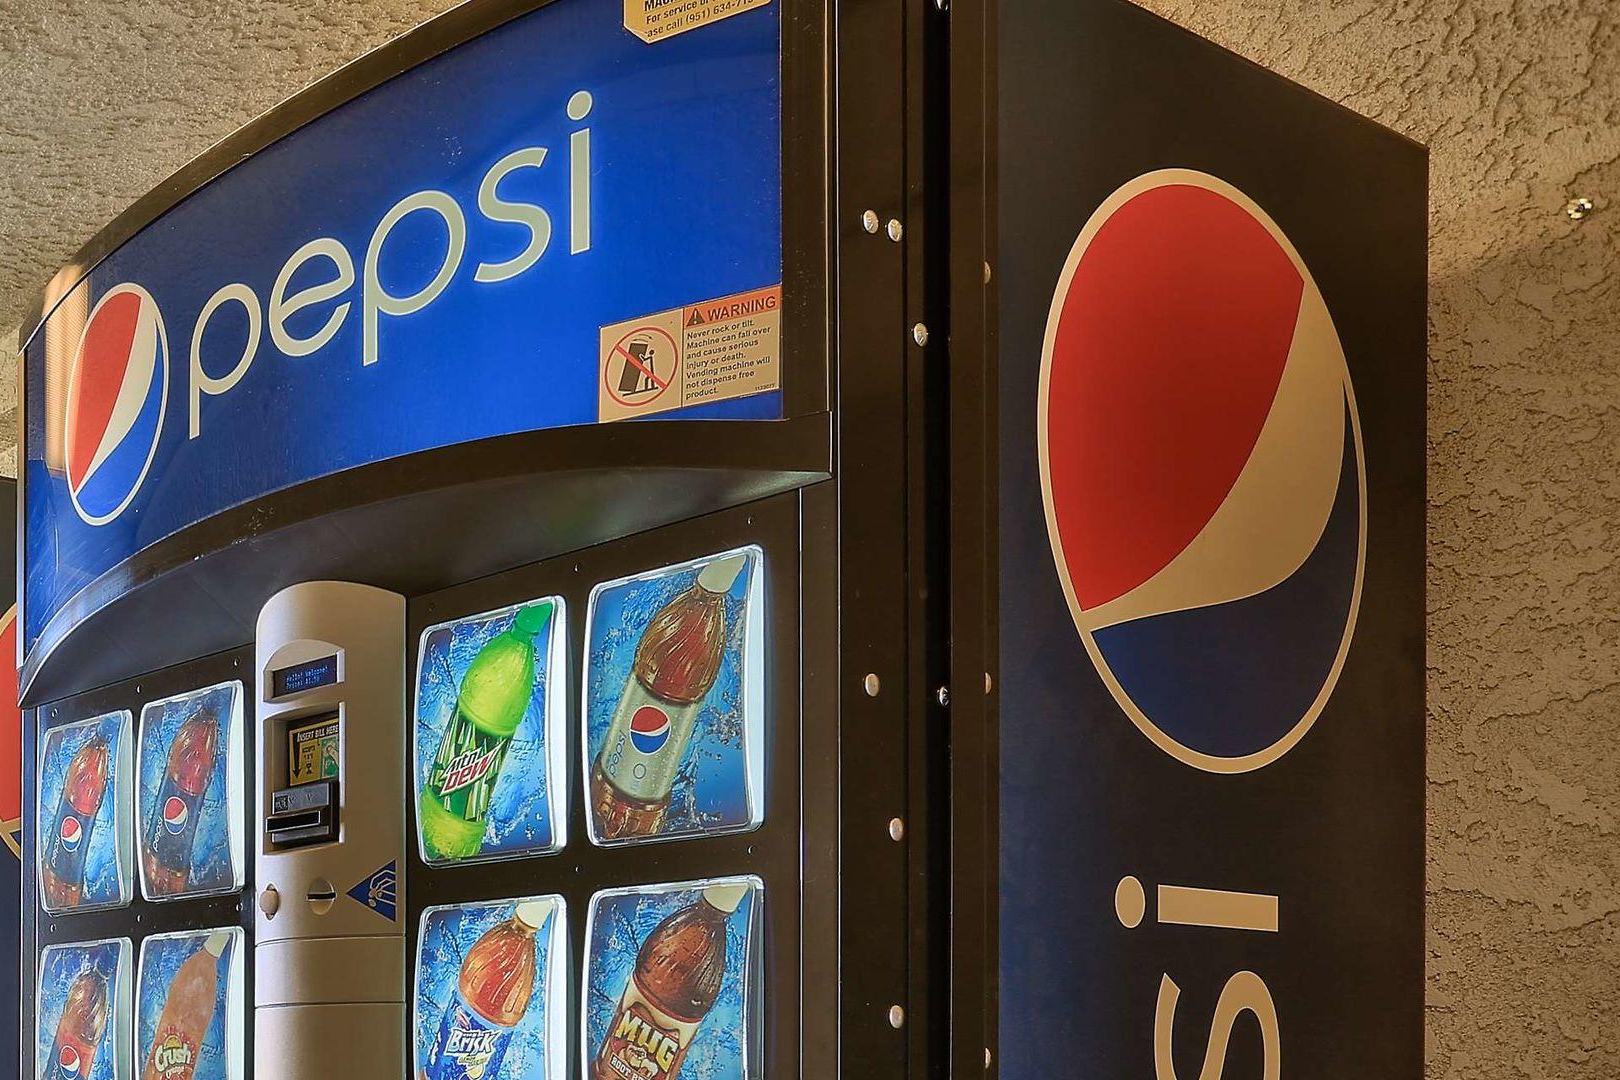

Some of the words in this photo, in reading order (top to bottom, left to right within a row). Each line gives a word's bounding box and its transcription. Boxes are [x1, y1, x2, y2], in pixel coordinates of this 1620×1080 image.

[646, 13, 661, 25] For
[663, 1, 698, 19] service
[666, 17, 683, 31] call
[686, 7, 711, 25] (951)
[189, 90, 593, 440] pepsi
[707, 295, 777, 322] WARNING
[686, 328, 710, 340] Never
[711, 324, 730, 336] rock
[731, 322, 741, 330] or
[686, 338, 720, 350] Machine
[721, 333, 737, 343] can
[738, 329, 751, 339] fall
[752, 326, 772, 336] over
[686, 350, 702, 360] and
[703, 347, 727, 357] cause
[728, 339, 759, 351] serious
[686, 358, 709, 370] injury
[710, 356, 720, 365] or
[721, 351, 747, 363] death.
[686, 367, 719, 380] Vending
[720, 359, 755, 372] machine
[756, 355, 771, 365] will
[685, 380, 700, 390] not
[700, 372, 737, 386] dispense
[738, 370, 755, 380] free
[296, 730, 314, 743] INSERT
[315, 727, 325, 738] BILL
[326, 724, 339, 736] HERE
[609, 730, 627, 778] pepsi
[444, 749, 497, 791] DEW
[153, 816, 163, 853] pepsi
[614, 1010, 679, 1073] MUG
[610, 1056, 632, 1077] ROOT
